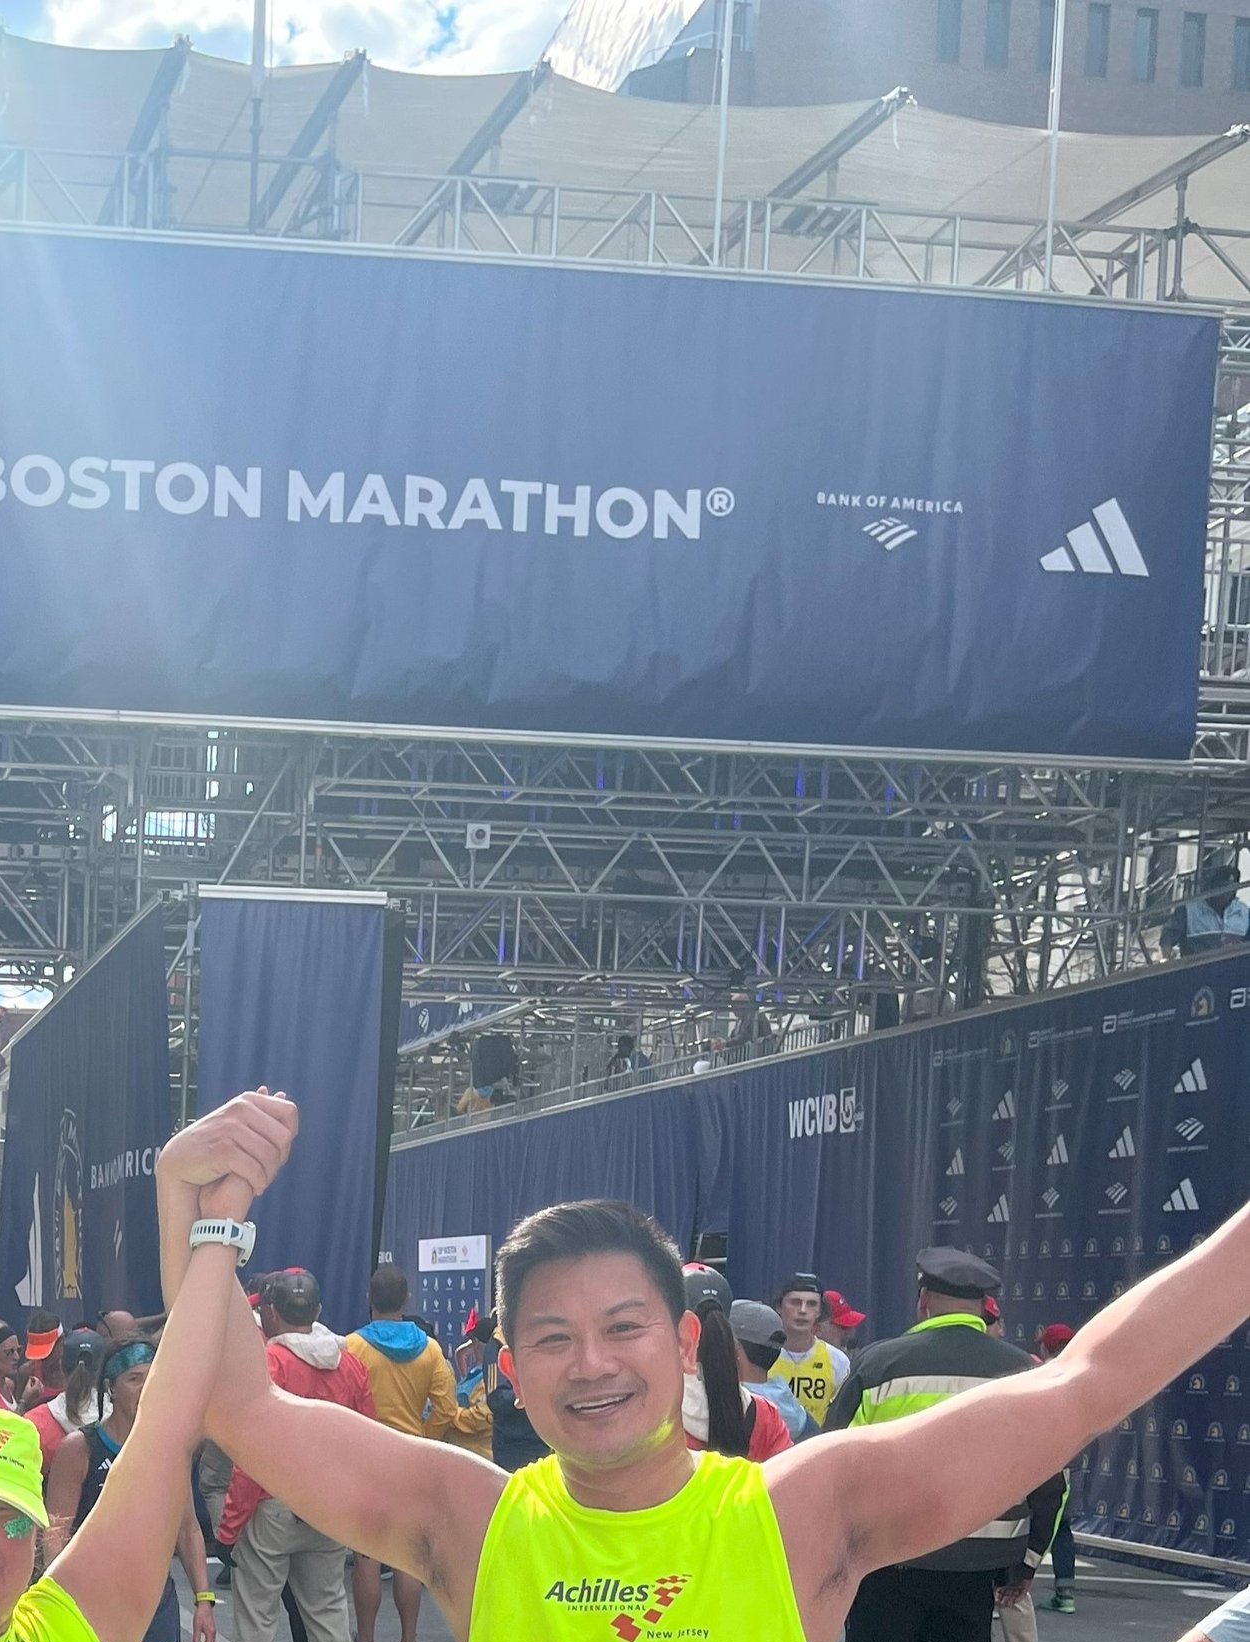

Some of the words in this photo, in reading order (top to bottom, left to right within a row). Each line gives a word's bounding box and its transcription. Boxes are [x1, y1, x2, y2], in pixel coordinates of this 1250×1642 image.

[816, 491, 861, 507] BANK
[866, 495, 887, 508] OF
[890, 497, 963, 514] AMERICA
[788, 1094, 837, 1139] WCVB
[544, 1578, 650, 1603] Achilles
[567, 1604, 647, 1612] INTERNATIONAL
[646, 1630, 673, 1639] New
